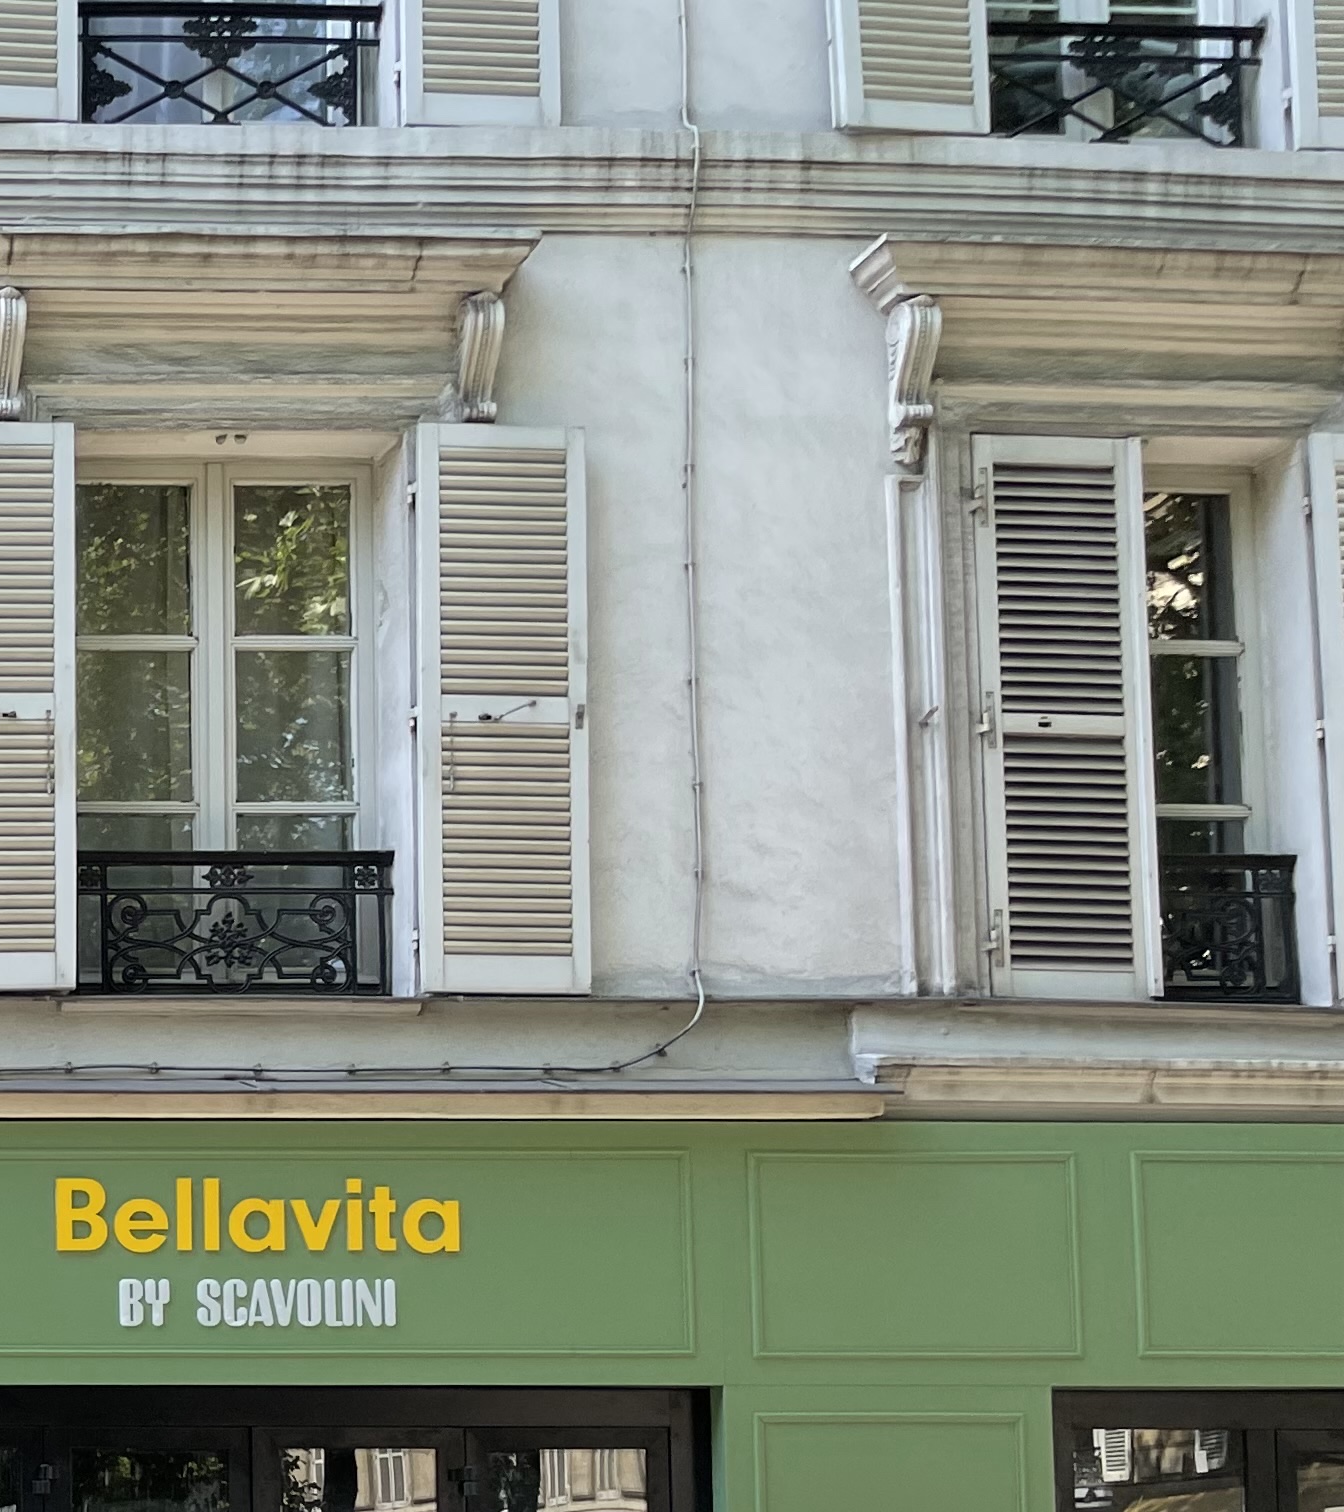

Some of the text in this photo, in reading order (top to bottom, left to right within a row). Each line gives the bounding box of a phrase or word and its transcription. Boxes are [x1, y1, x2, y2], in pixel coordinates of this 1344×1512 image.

[54, 1177, 461, 1254] Bellavita
[119, 1278, 397, 1328] BY SCAVOLINI
